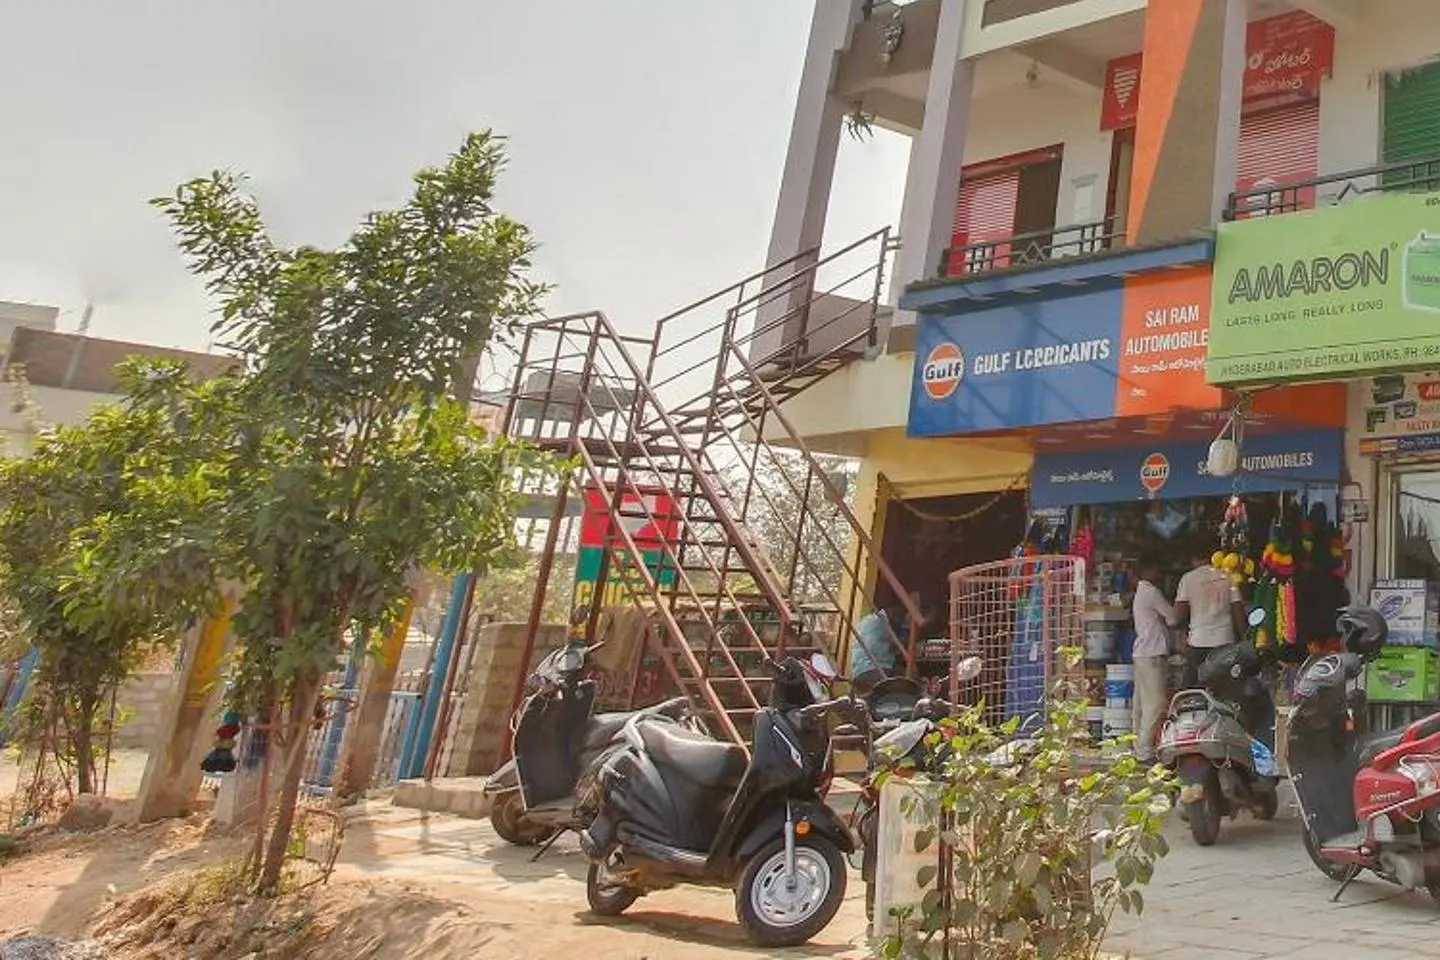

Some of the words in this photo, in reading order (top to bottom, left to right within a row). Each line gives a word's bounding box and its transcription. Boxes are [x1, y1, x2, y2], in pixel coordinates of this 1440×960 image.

[1227, 247, 1390, 305] AMARON
[1144, 309, 1167, 329] SAI
[1169, 304, 1200, 325] RAM
[1125, 328, 1209, 356] AUTOMOBILE
[924, 361, 963, 381] Gulf
[973, 352, 1011, 375] GULF
[1242, 452, 1314, 471] AUTOMOBILES
